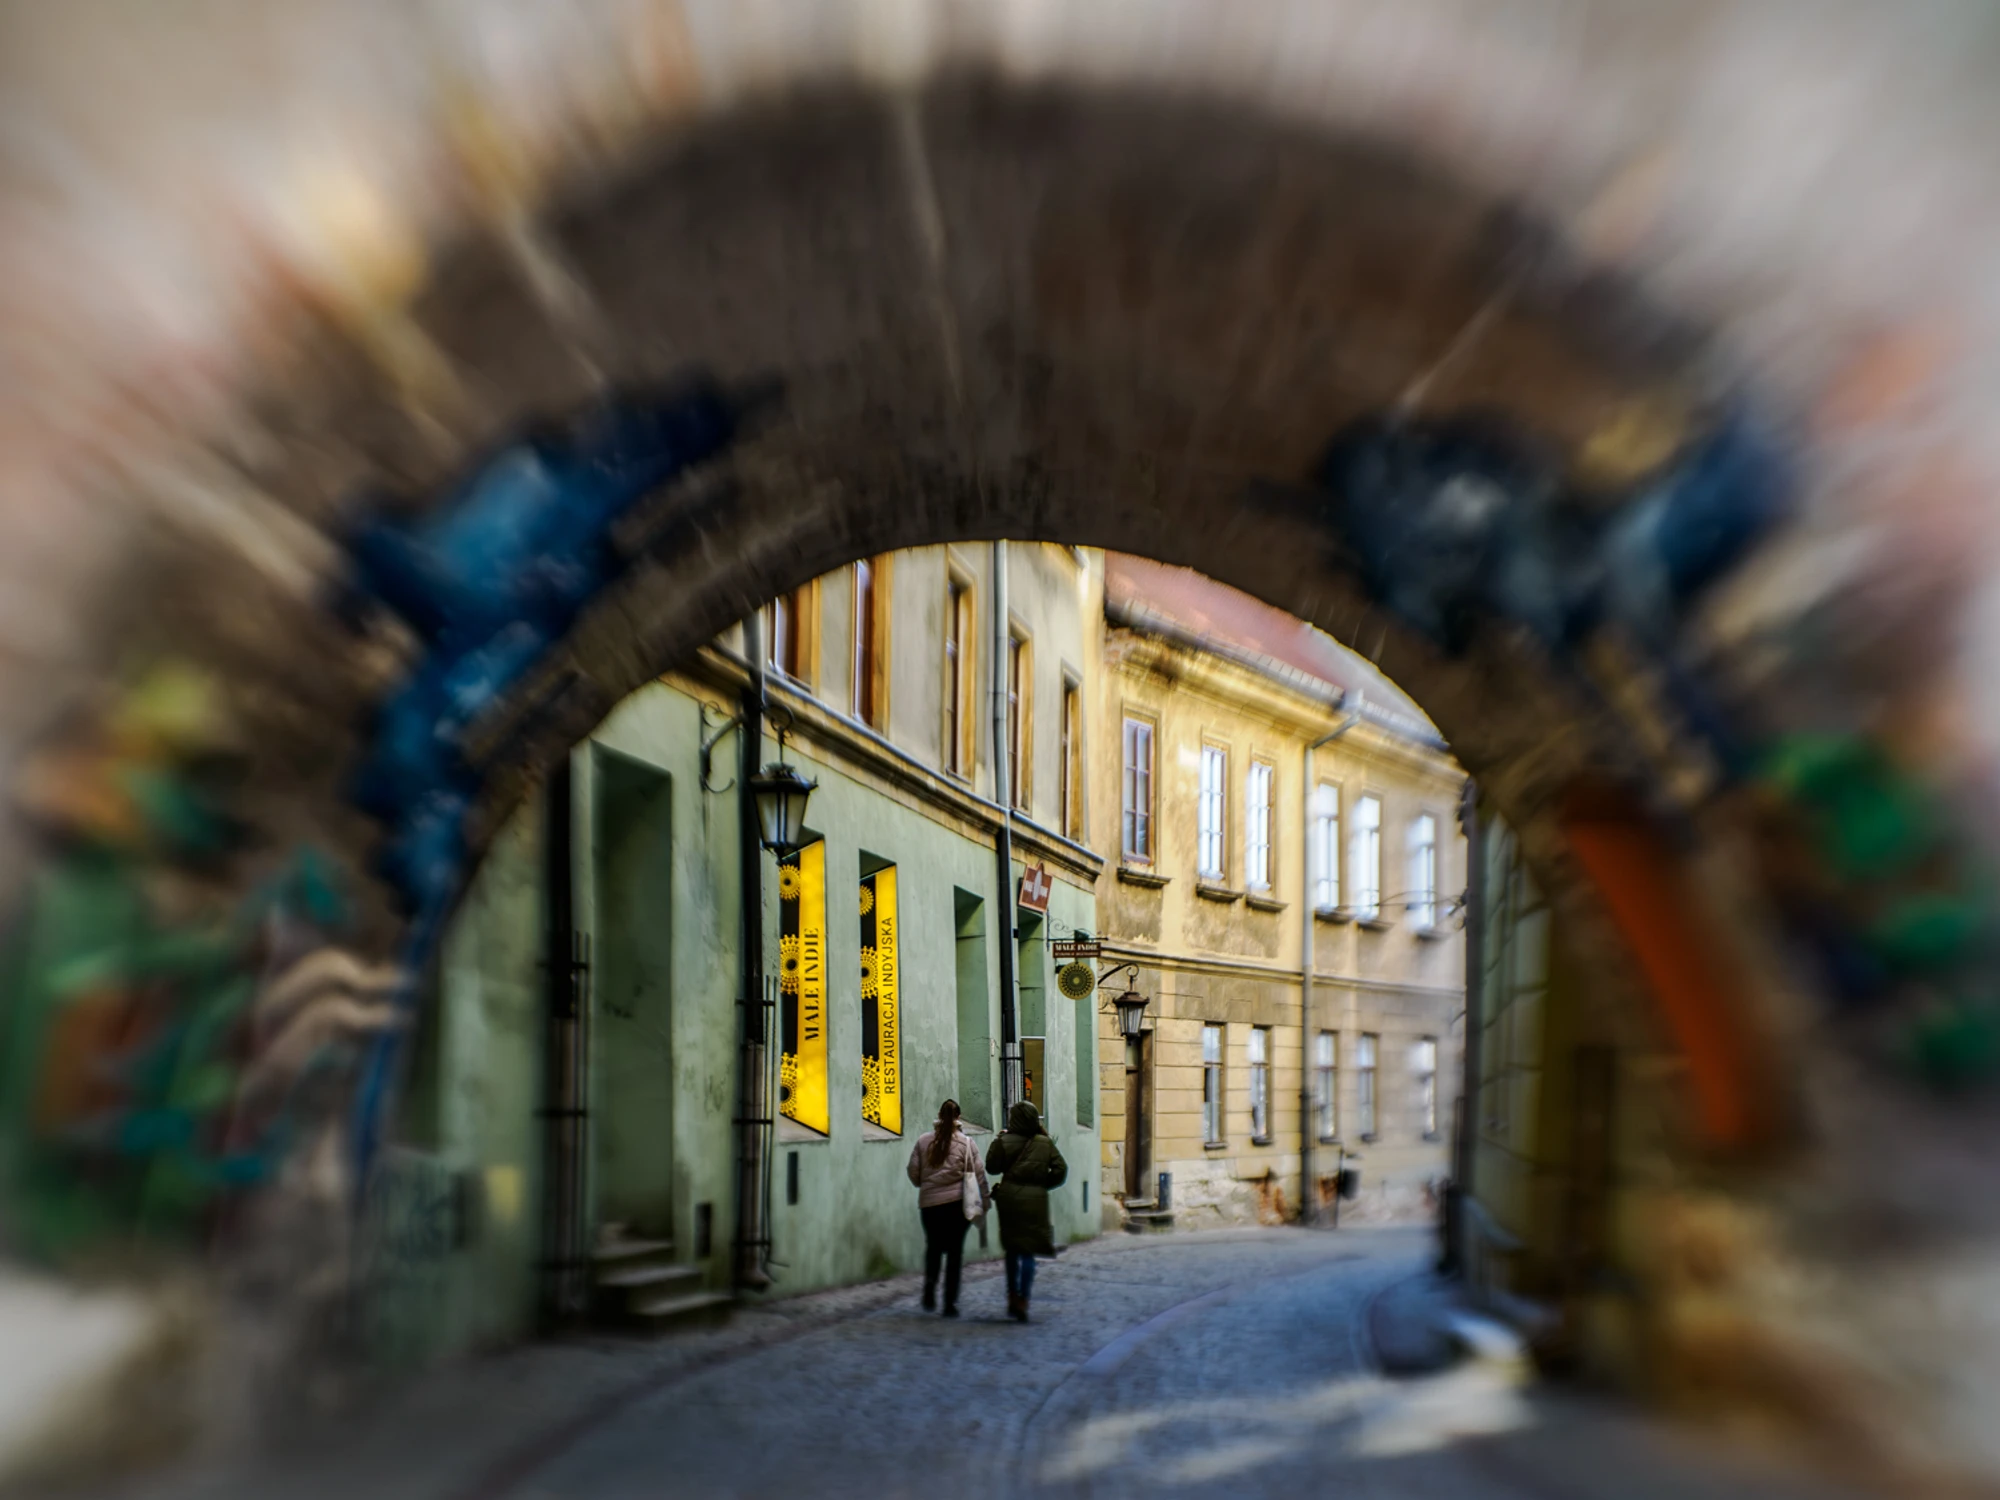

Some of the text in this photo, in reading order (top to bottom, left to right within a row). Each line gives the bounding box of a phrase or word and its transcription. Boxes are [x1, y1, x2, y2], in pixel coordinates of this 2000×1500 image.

[804, 928, 819, 1041] MAŁE INDIE
[881, 917, 895, 1094] RESTAURACJA INDYJSKA
